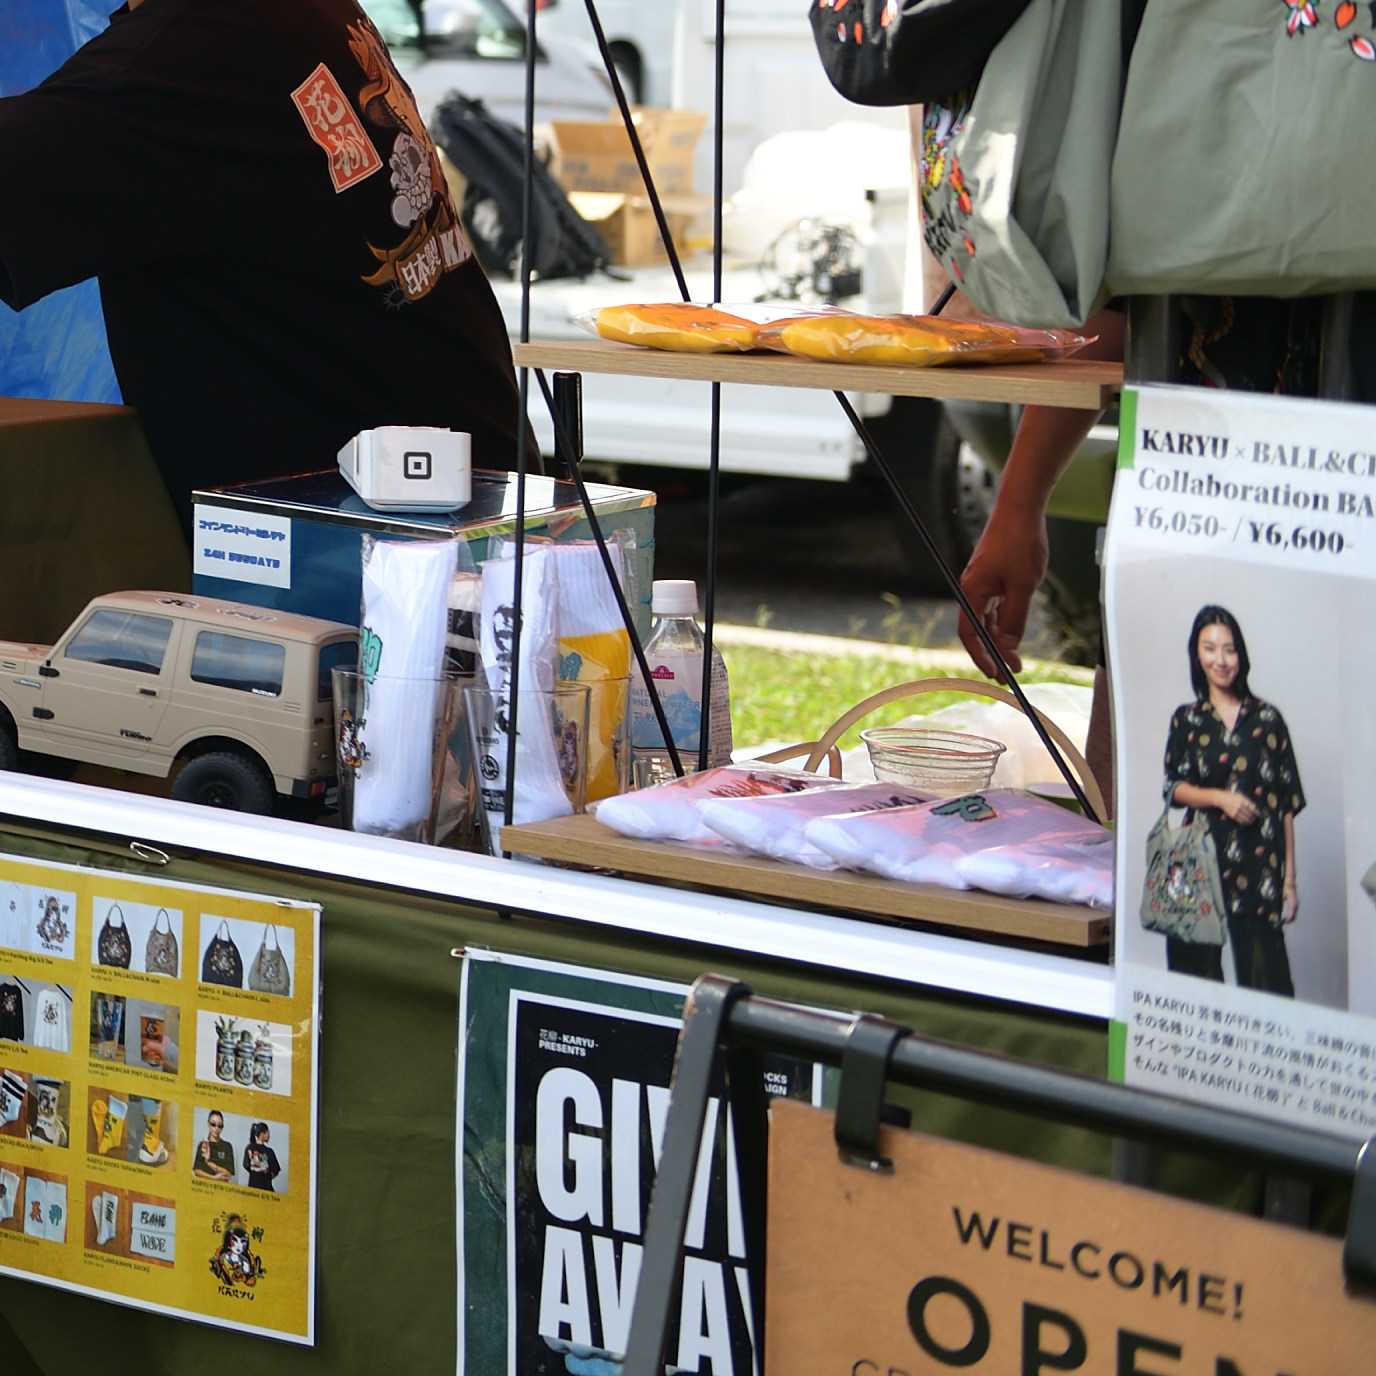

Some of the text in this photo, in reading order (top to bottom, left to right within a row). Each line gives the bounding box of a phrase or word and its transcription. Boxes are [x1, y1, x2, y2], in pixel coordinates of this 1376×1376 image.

[400, 235, 442, 295] 日本製
[1142, 429, 1230, 459] KARYU
[1138, 467, 1330, 512] Collaboration
[1134, 506, 1227, 538] ¥6,050-
[1247, 520, 1354, 554] ¥6,600-
[1133, 990, 1195, 1016] IPA KARYU
[538, 1039, 587, 1057] PRESENTS
[952, 1205, 1245, 1321] WELCOME!
